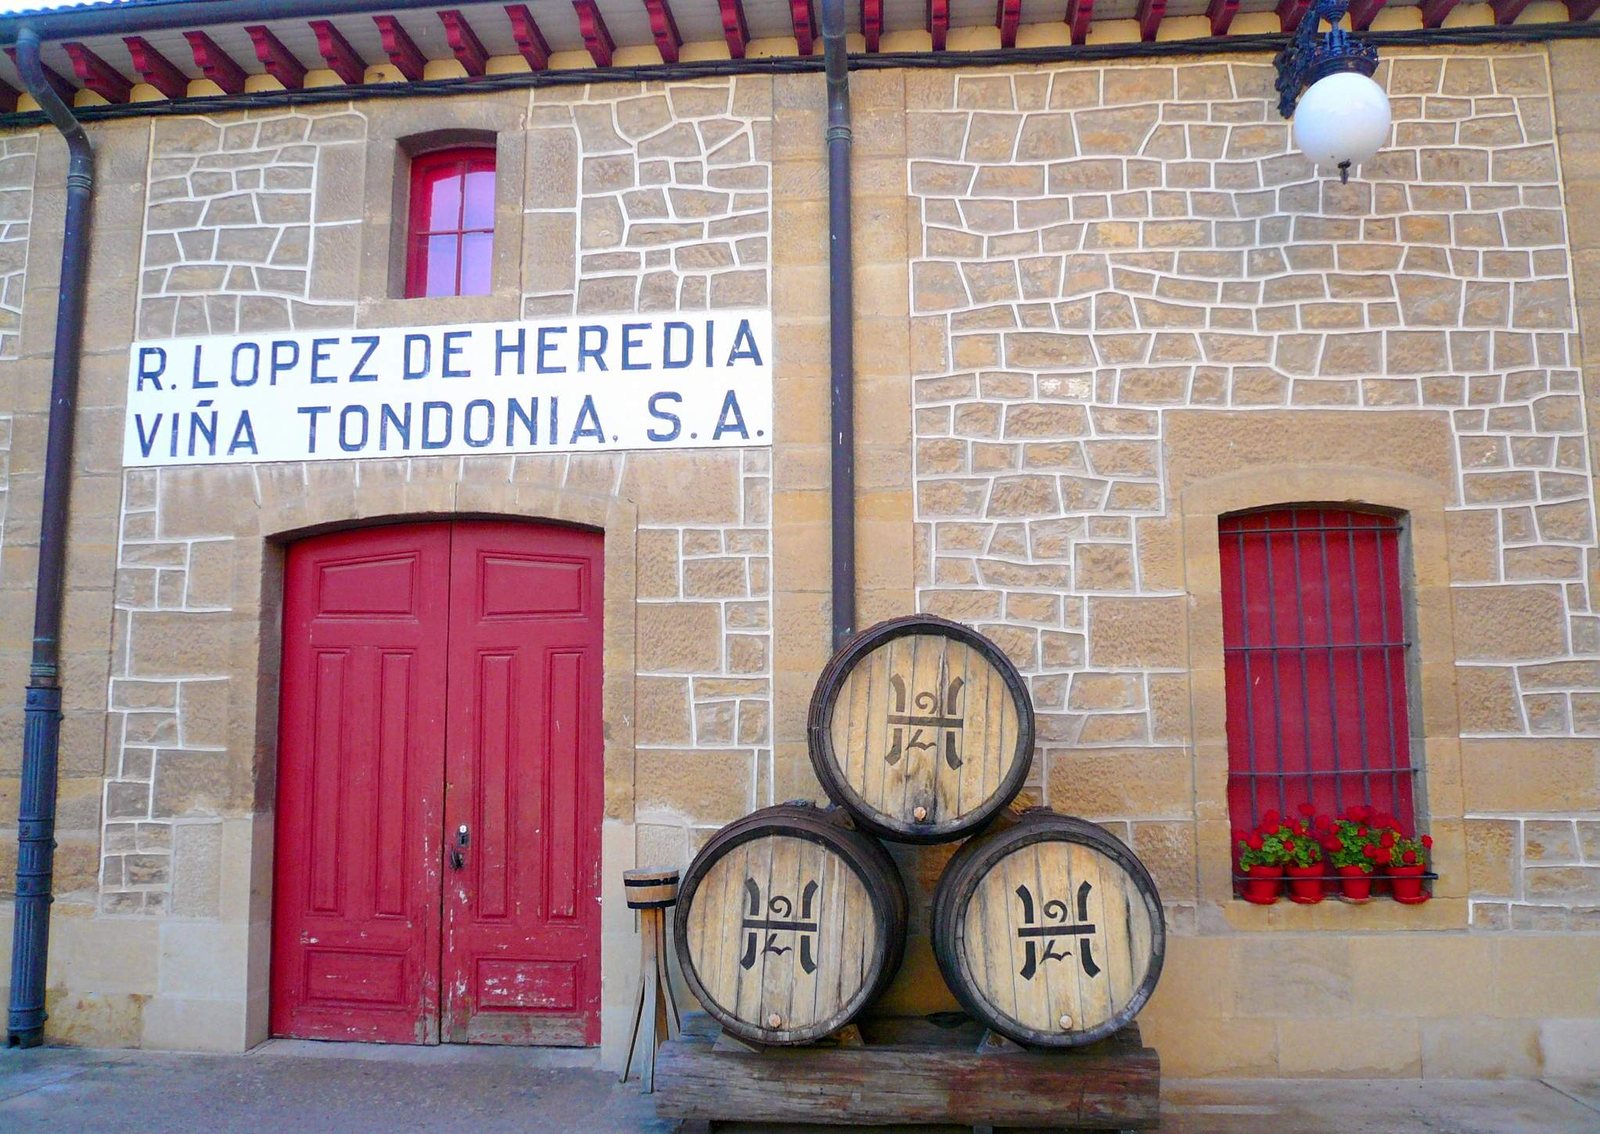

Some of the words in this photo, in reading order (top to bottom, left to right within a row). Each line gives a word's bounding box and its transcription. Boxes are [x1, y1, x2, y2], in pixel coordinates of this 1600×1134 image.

[402, 330, 473, 381] DE
[494, 319, 764, 377] HEREDIA
[134, 399, 259, 458] VIÑA
